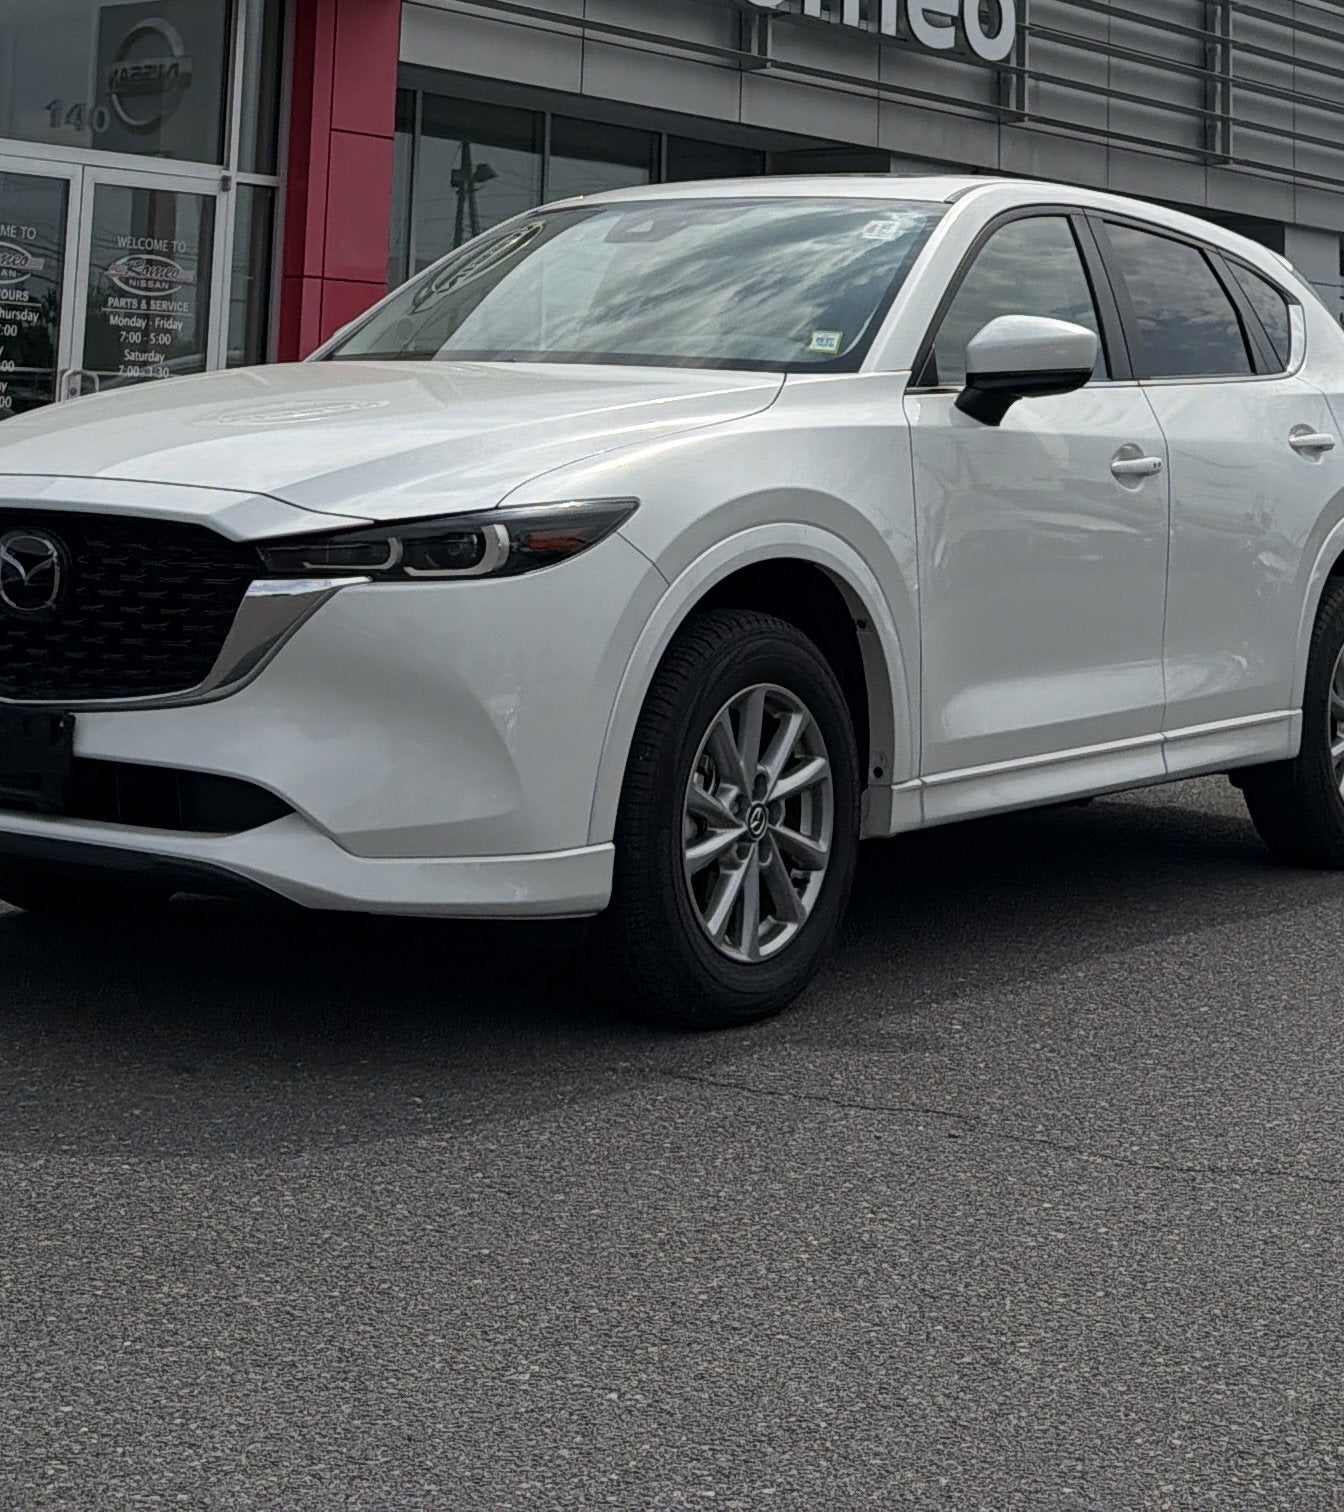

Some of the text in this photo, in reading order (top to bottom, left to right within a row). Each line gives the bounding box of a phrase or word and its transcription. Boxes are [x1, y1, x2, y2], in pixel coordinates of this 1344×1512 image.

[45, 98, 111, 133] 140
[19, 226, 36, 239] TO
[117, 236, 186, 253] WELCOME TO
[125, 256, 181, 279] Romeo
[128, 279, 170, 289] NISSAN
[107, 296, 189, 312] PARTS & SERVICE
[109, 314, 147, 330] Monday
[155, 316, 183, 332] Friday
[120, 331, 142, 343] 7:00
[149, 333, 171, 345] 5:00
[124, 349, 165, 365] Saturday
[118, 364, 140, 377] 7:00
